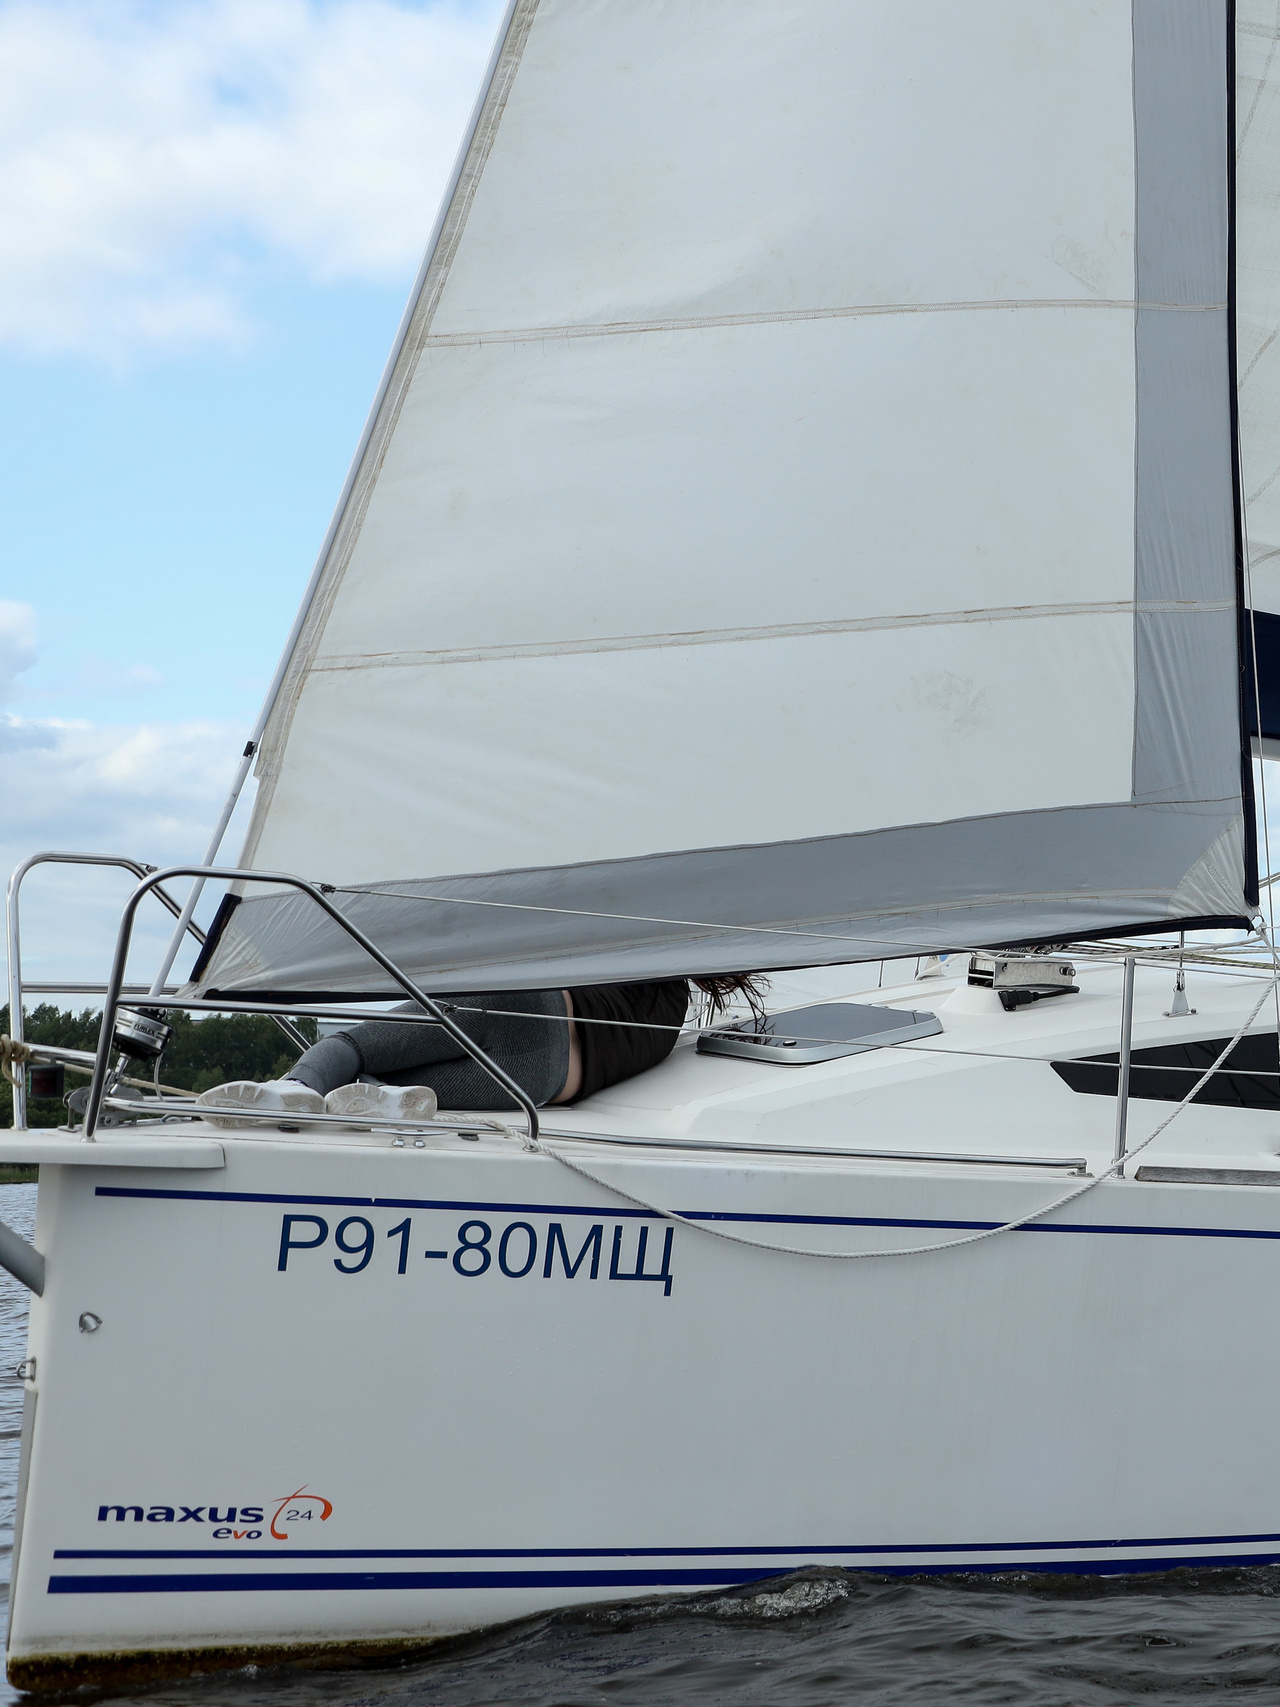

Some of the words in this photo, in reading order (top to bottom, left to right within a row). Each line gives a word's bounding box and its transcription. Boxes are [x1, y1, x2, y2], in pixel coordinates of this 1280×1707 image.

[277, 1214, 675, 1296] Р91-80МЩ
[97, 1505, 264, 1523] maxus
[286, 1509, 314, 1521] 24
[212, 1527, 262, 1540] evo
